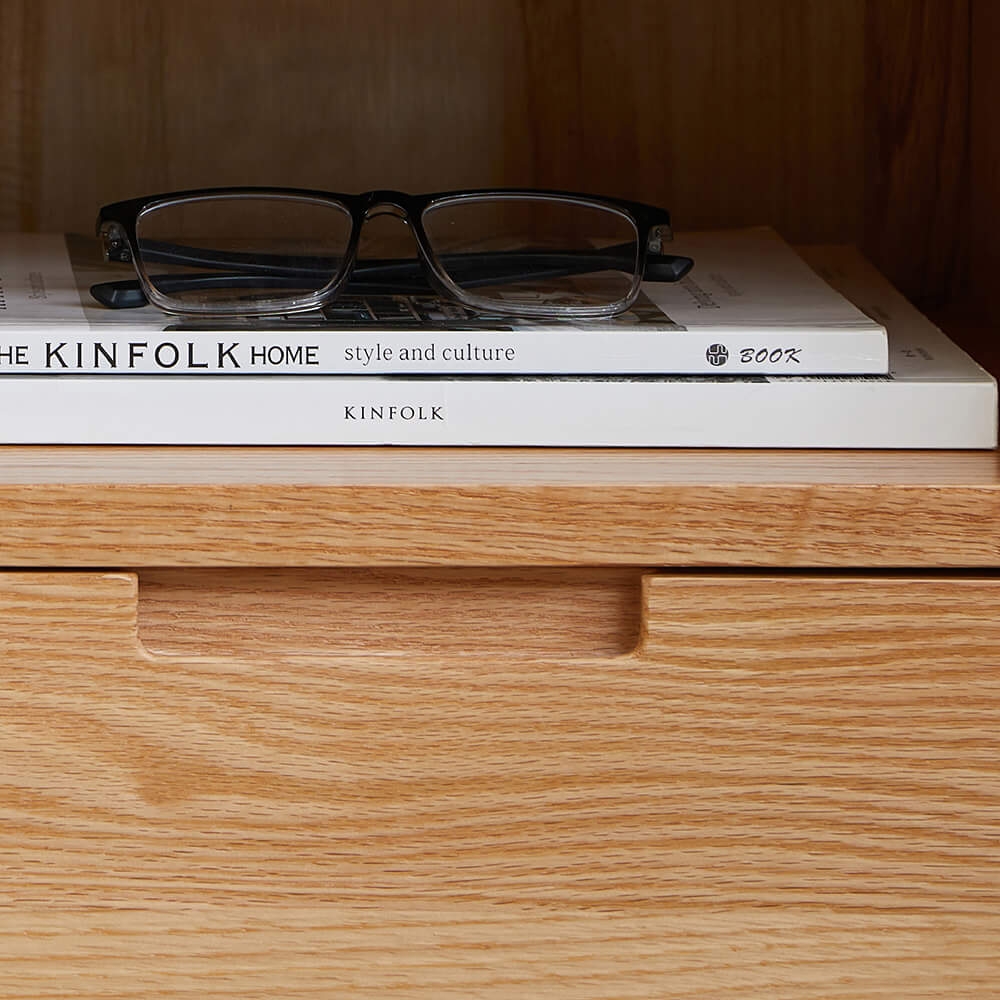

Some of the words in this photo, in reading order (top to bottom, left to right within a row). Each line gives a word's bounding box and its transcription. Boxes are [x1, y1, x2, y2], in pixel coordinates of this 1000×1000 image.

[45, 342, 241, 369] KINFOLK
[250, 345, 320, 366] HOME
[344, 343, 393, 367] style
[399, 343, 435, 361] and
[442, 343, 515, 361] culture
[739, 347, 803, 364] BOOK
[344, 405, 444, 421] KINFOLK
